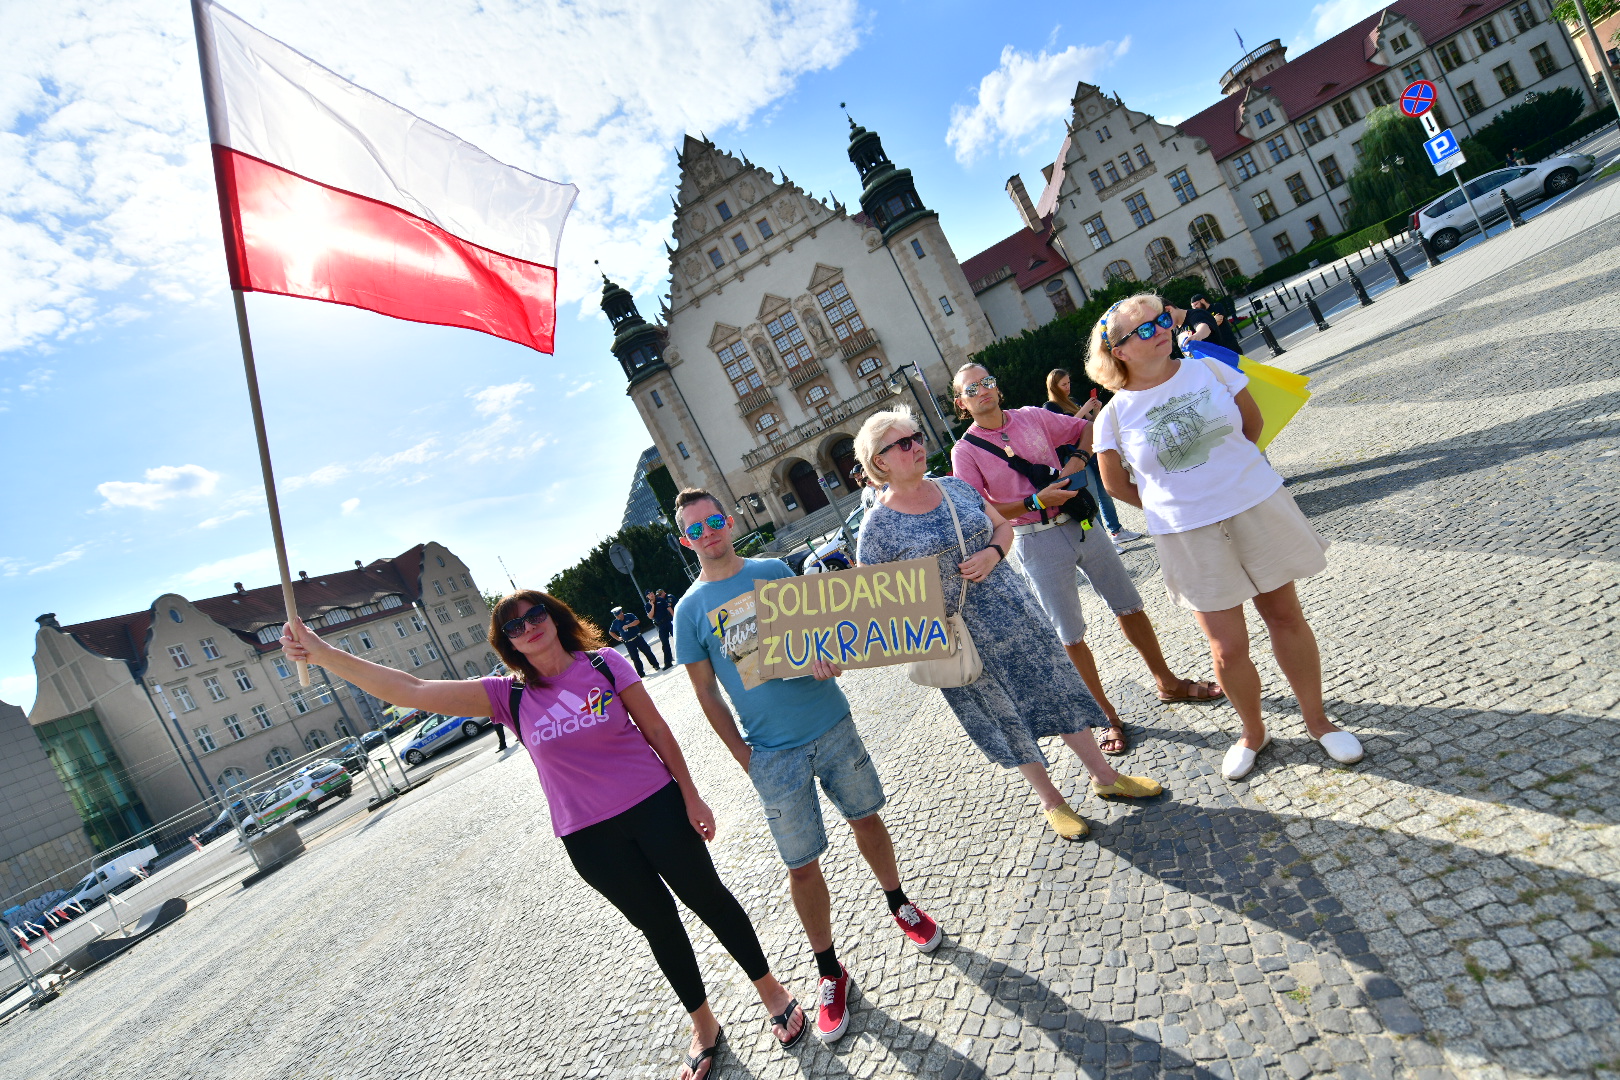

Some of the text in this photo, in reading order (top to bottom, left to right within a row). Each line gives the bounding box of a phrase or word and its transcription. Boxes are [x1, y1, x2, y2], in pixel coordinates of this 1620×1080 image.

[1430, 136, 1450, 159] P
[729, 606, 745, 618] San
[746, 601, 756, 611] Jo
[759, 568, 926, 624] SOLIDARNI
[719, 622, 758, 659] Adve
[784, 616, 949, 670] UKRAINA
[530, 709, 610, 746] adidas
